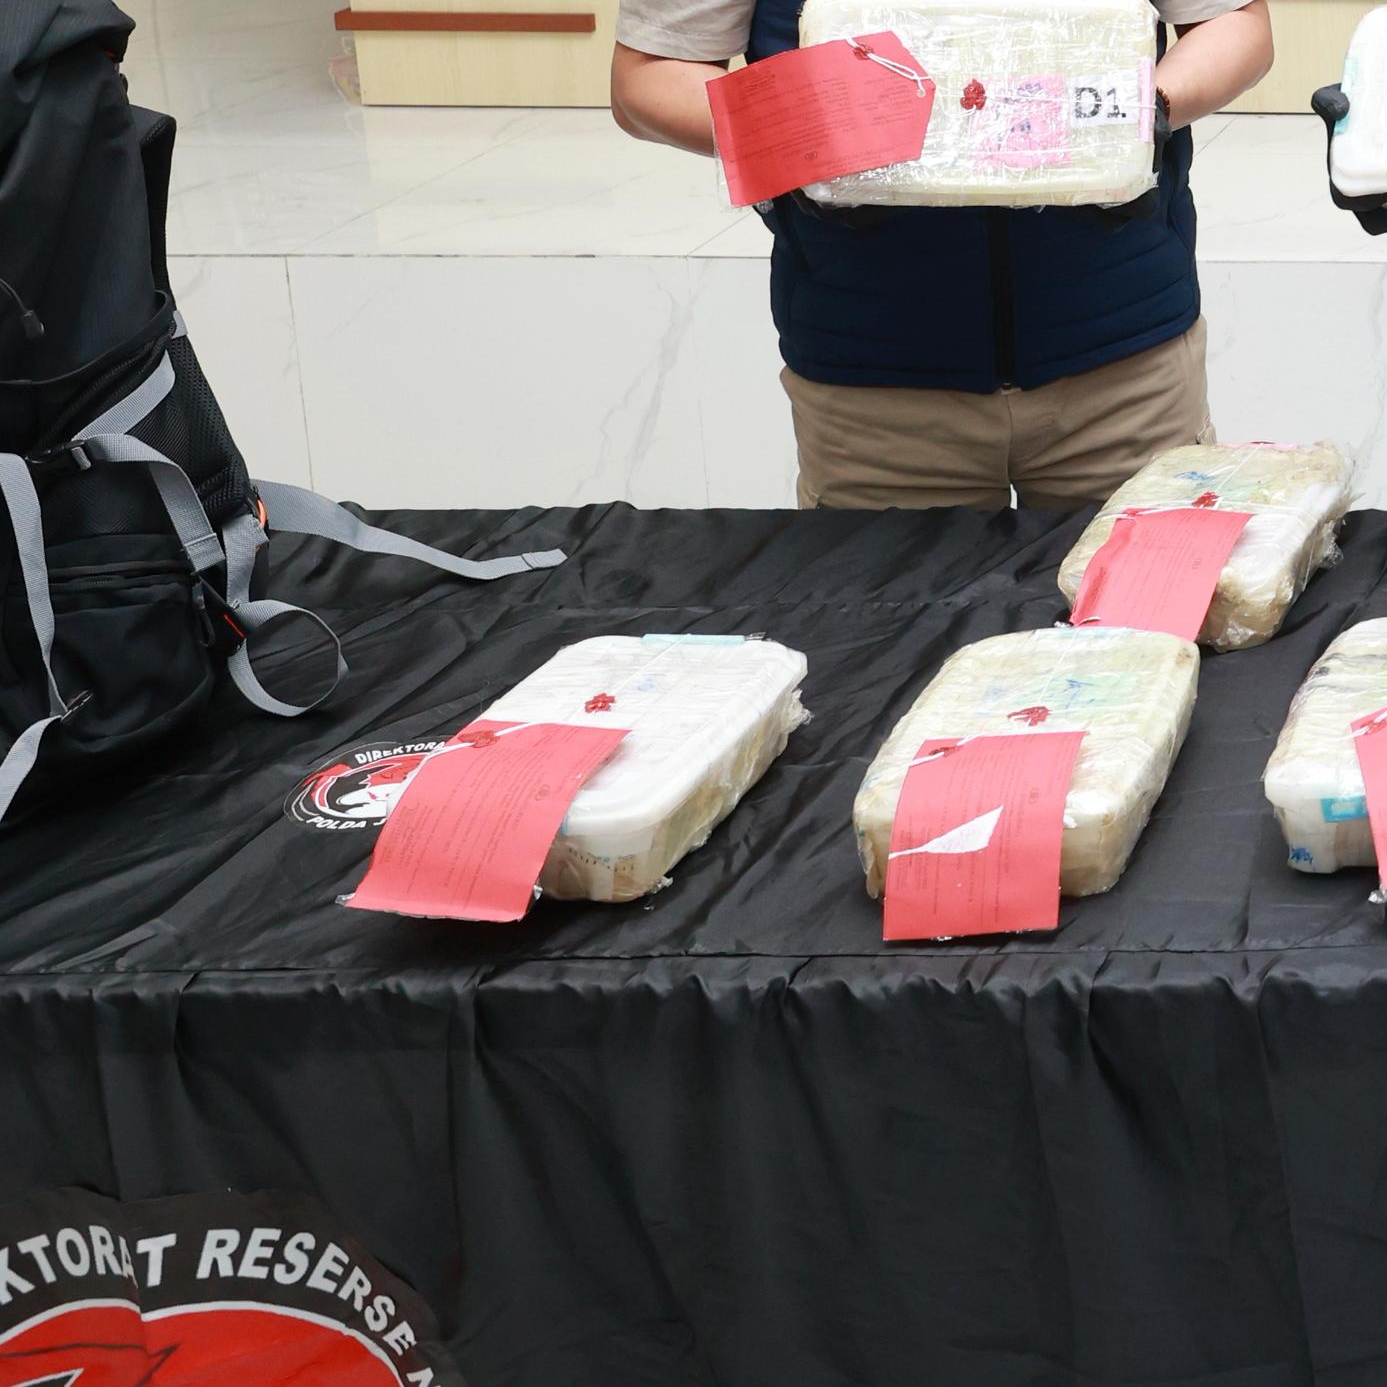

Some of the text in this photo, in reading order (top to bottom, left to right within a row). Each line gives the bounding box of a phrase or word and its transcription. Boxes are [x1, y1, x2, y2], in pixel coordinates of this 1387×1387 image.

[355, 741, 446, 765] DIREKTORA
[306, 815, 366, 829] POLDA
[197, 1228, 417, 1356] RESERSE
